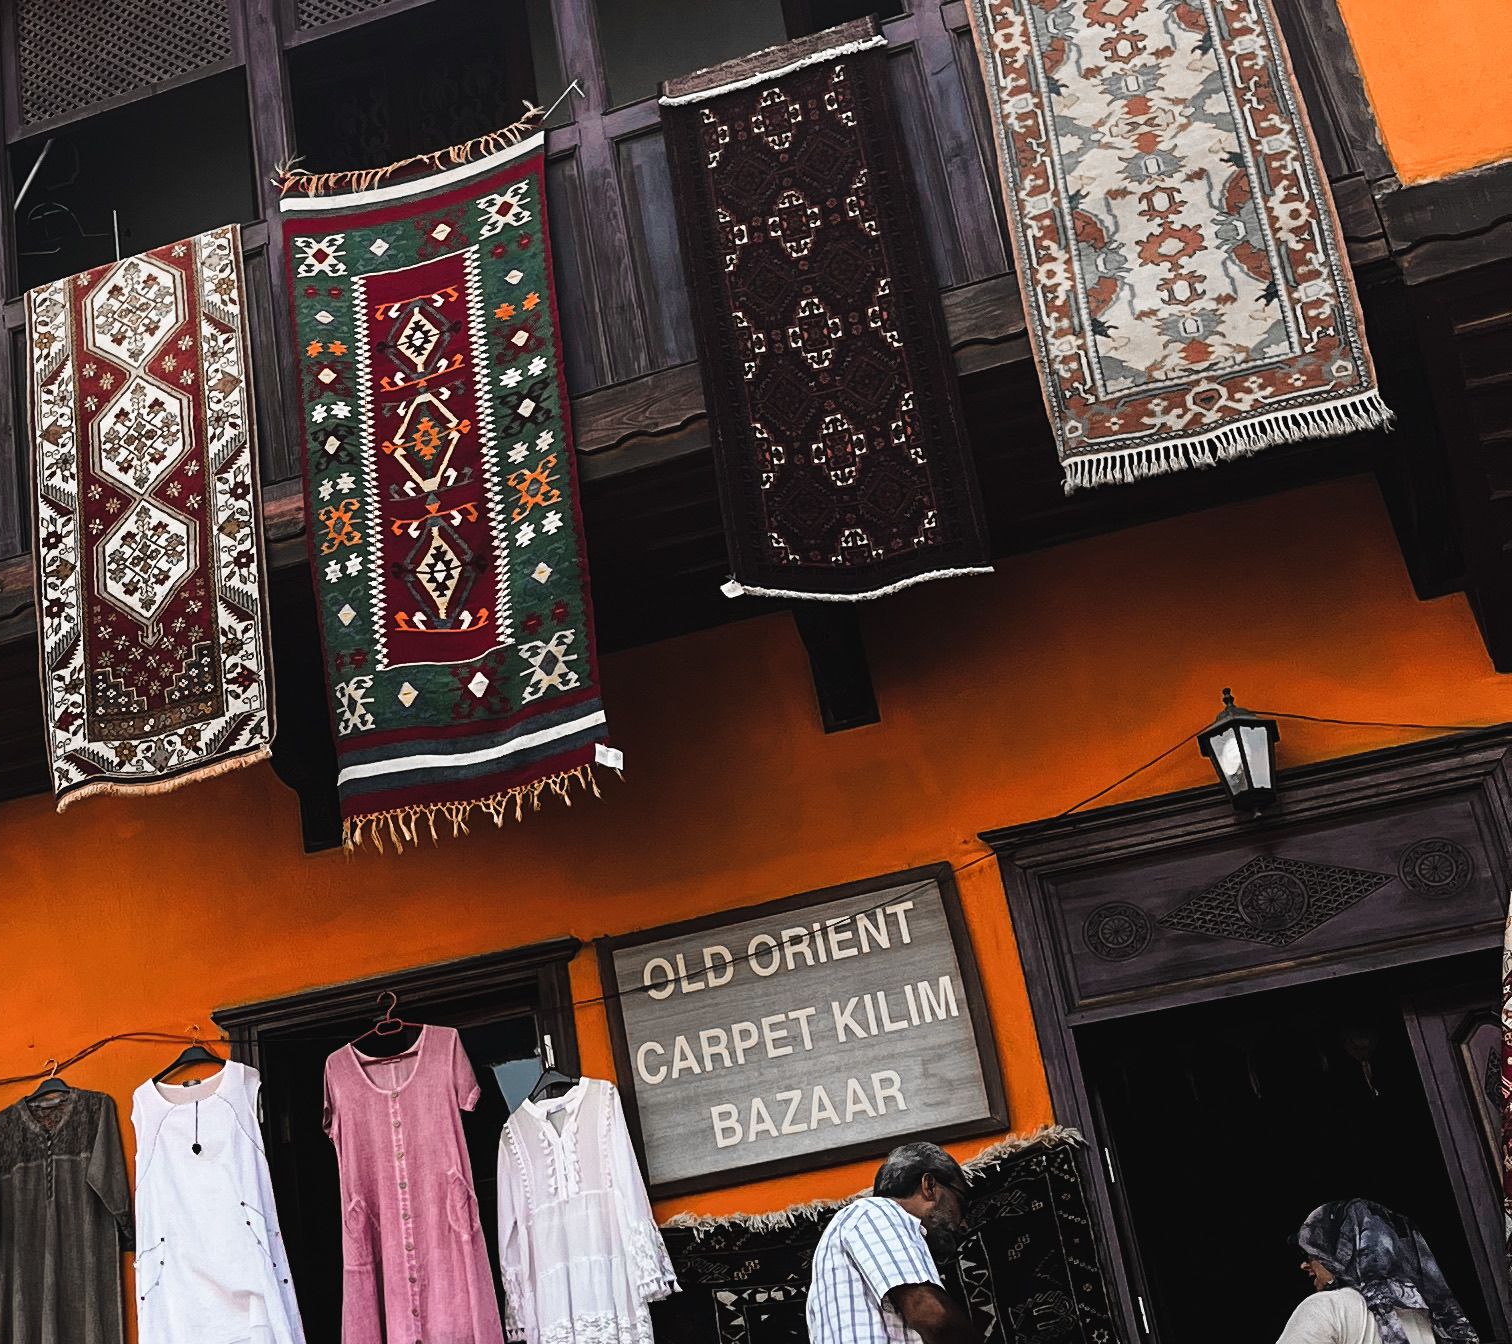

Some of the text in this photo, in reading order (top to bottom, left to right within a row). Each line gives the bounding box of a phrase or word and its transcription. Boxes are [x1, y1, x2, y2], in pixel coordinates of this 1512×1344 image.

[642, 944, 735, 1001] OLD
[636, 974, 959, 1085] CARPET KILIM
[710, 1069, 908, 1150] BAZAAR
